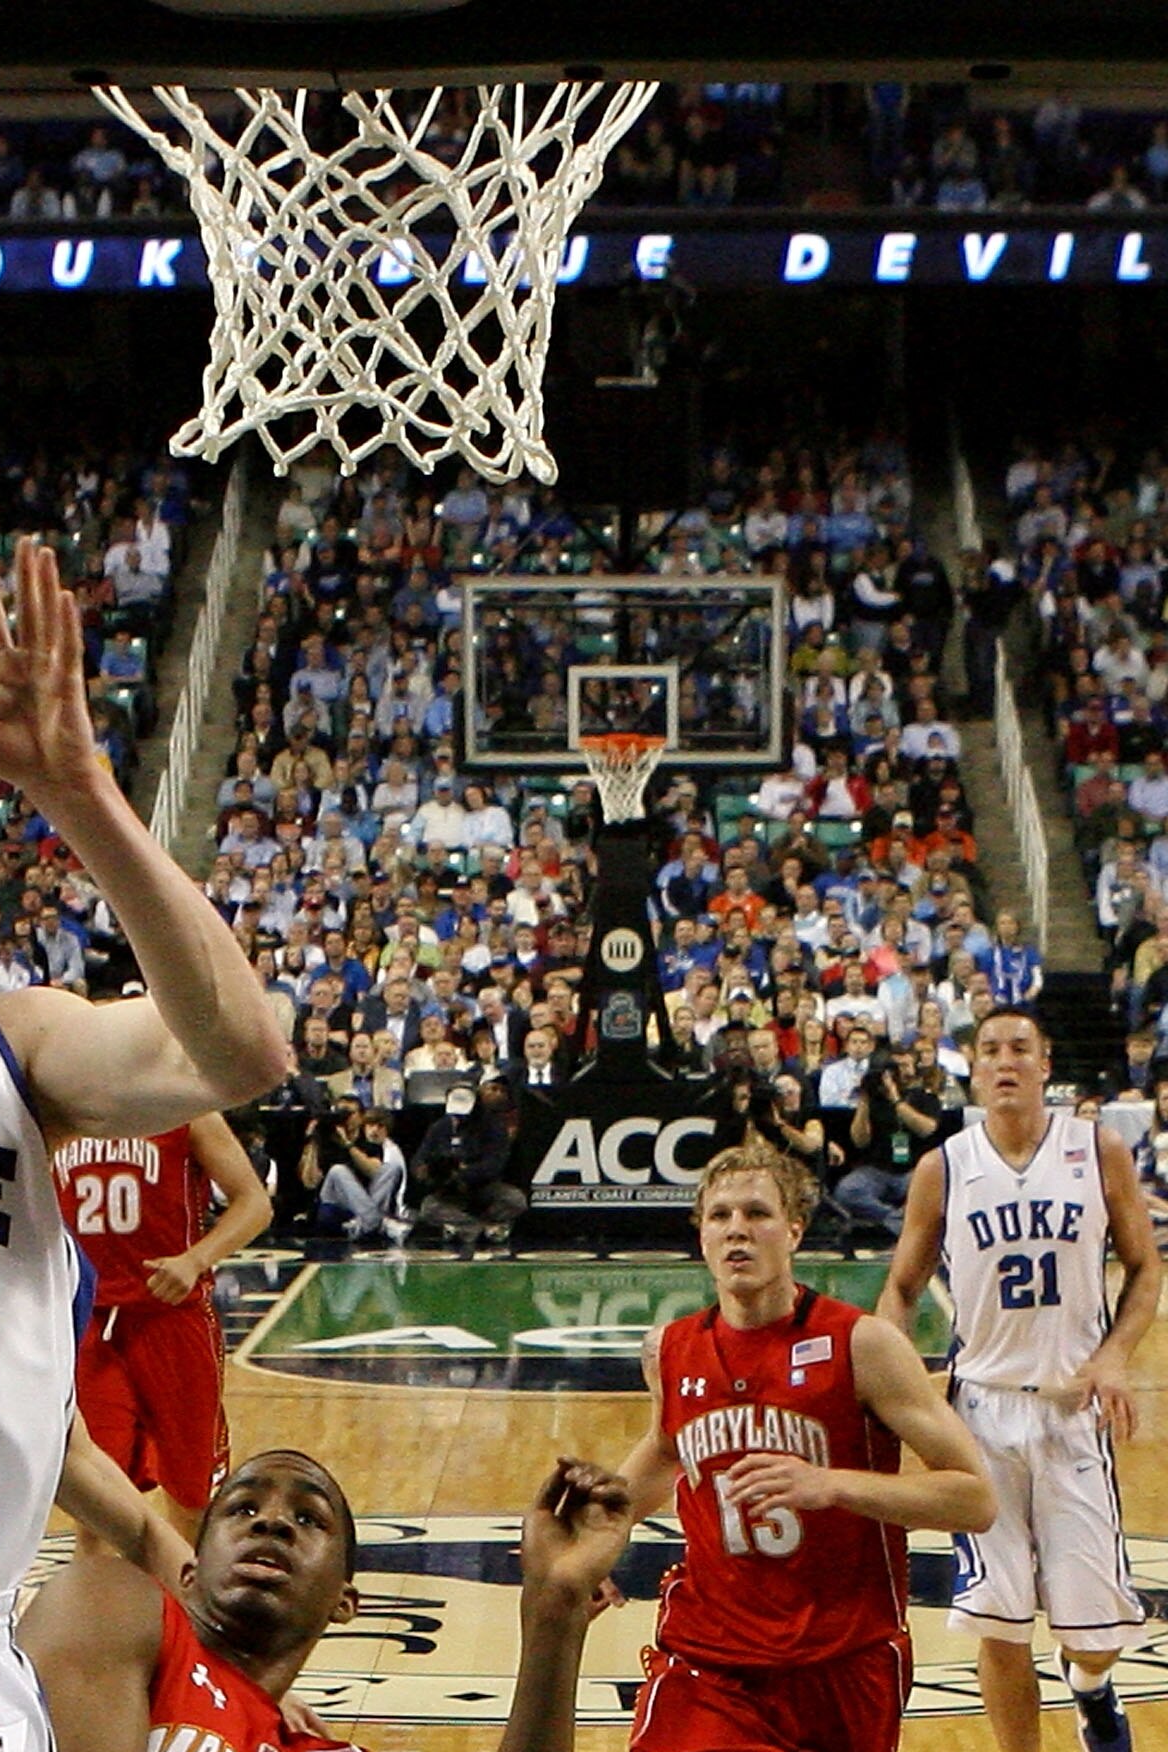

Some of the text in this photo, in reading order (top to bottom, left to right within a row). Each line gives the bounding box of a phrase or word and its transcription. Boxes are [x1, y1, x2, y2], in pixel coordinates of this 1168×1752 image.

[784, 231, 1153, 283] DEVIL
[53, 1136, 160, 1190] MARYLAND
[532, 1116, 718, 1186] ACC
[75, 1173, 141, 1235] 20
[967, 1199, 1084, 1251] DUKE
[997, 1250, 1062, 1310] 21
[675, 1404, 830, 1494] MARYLAND
